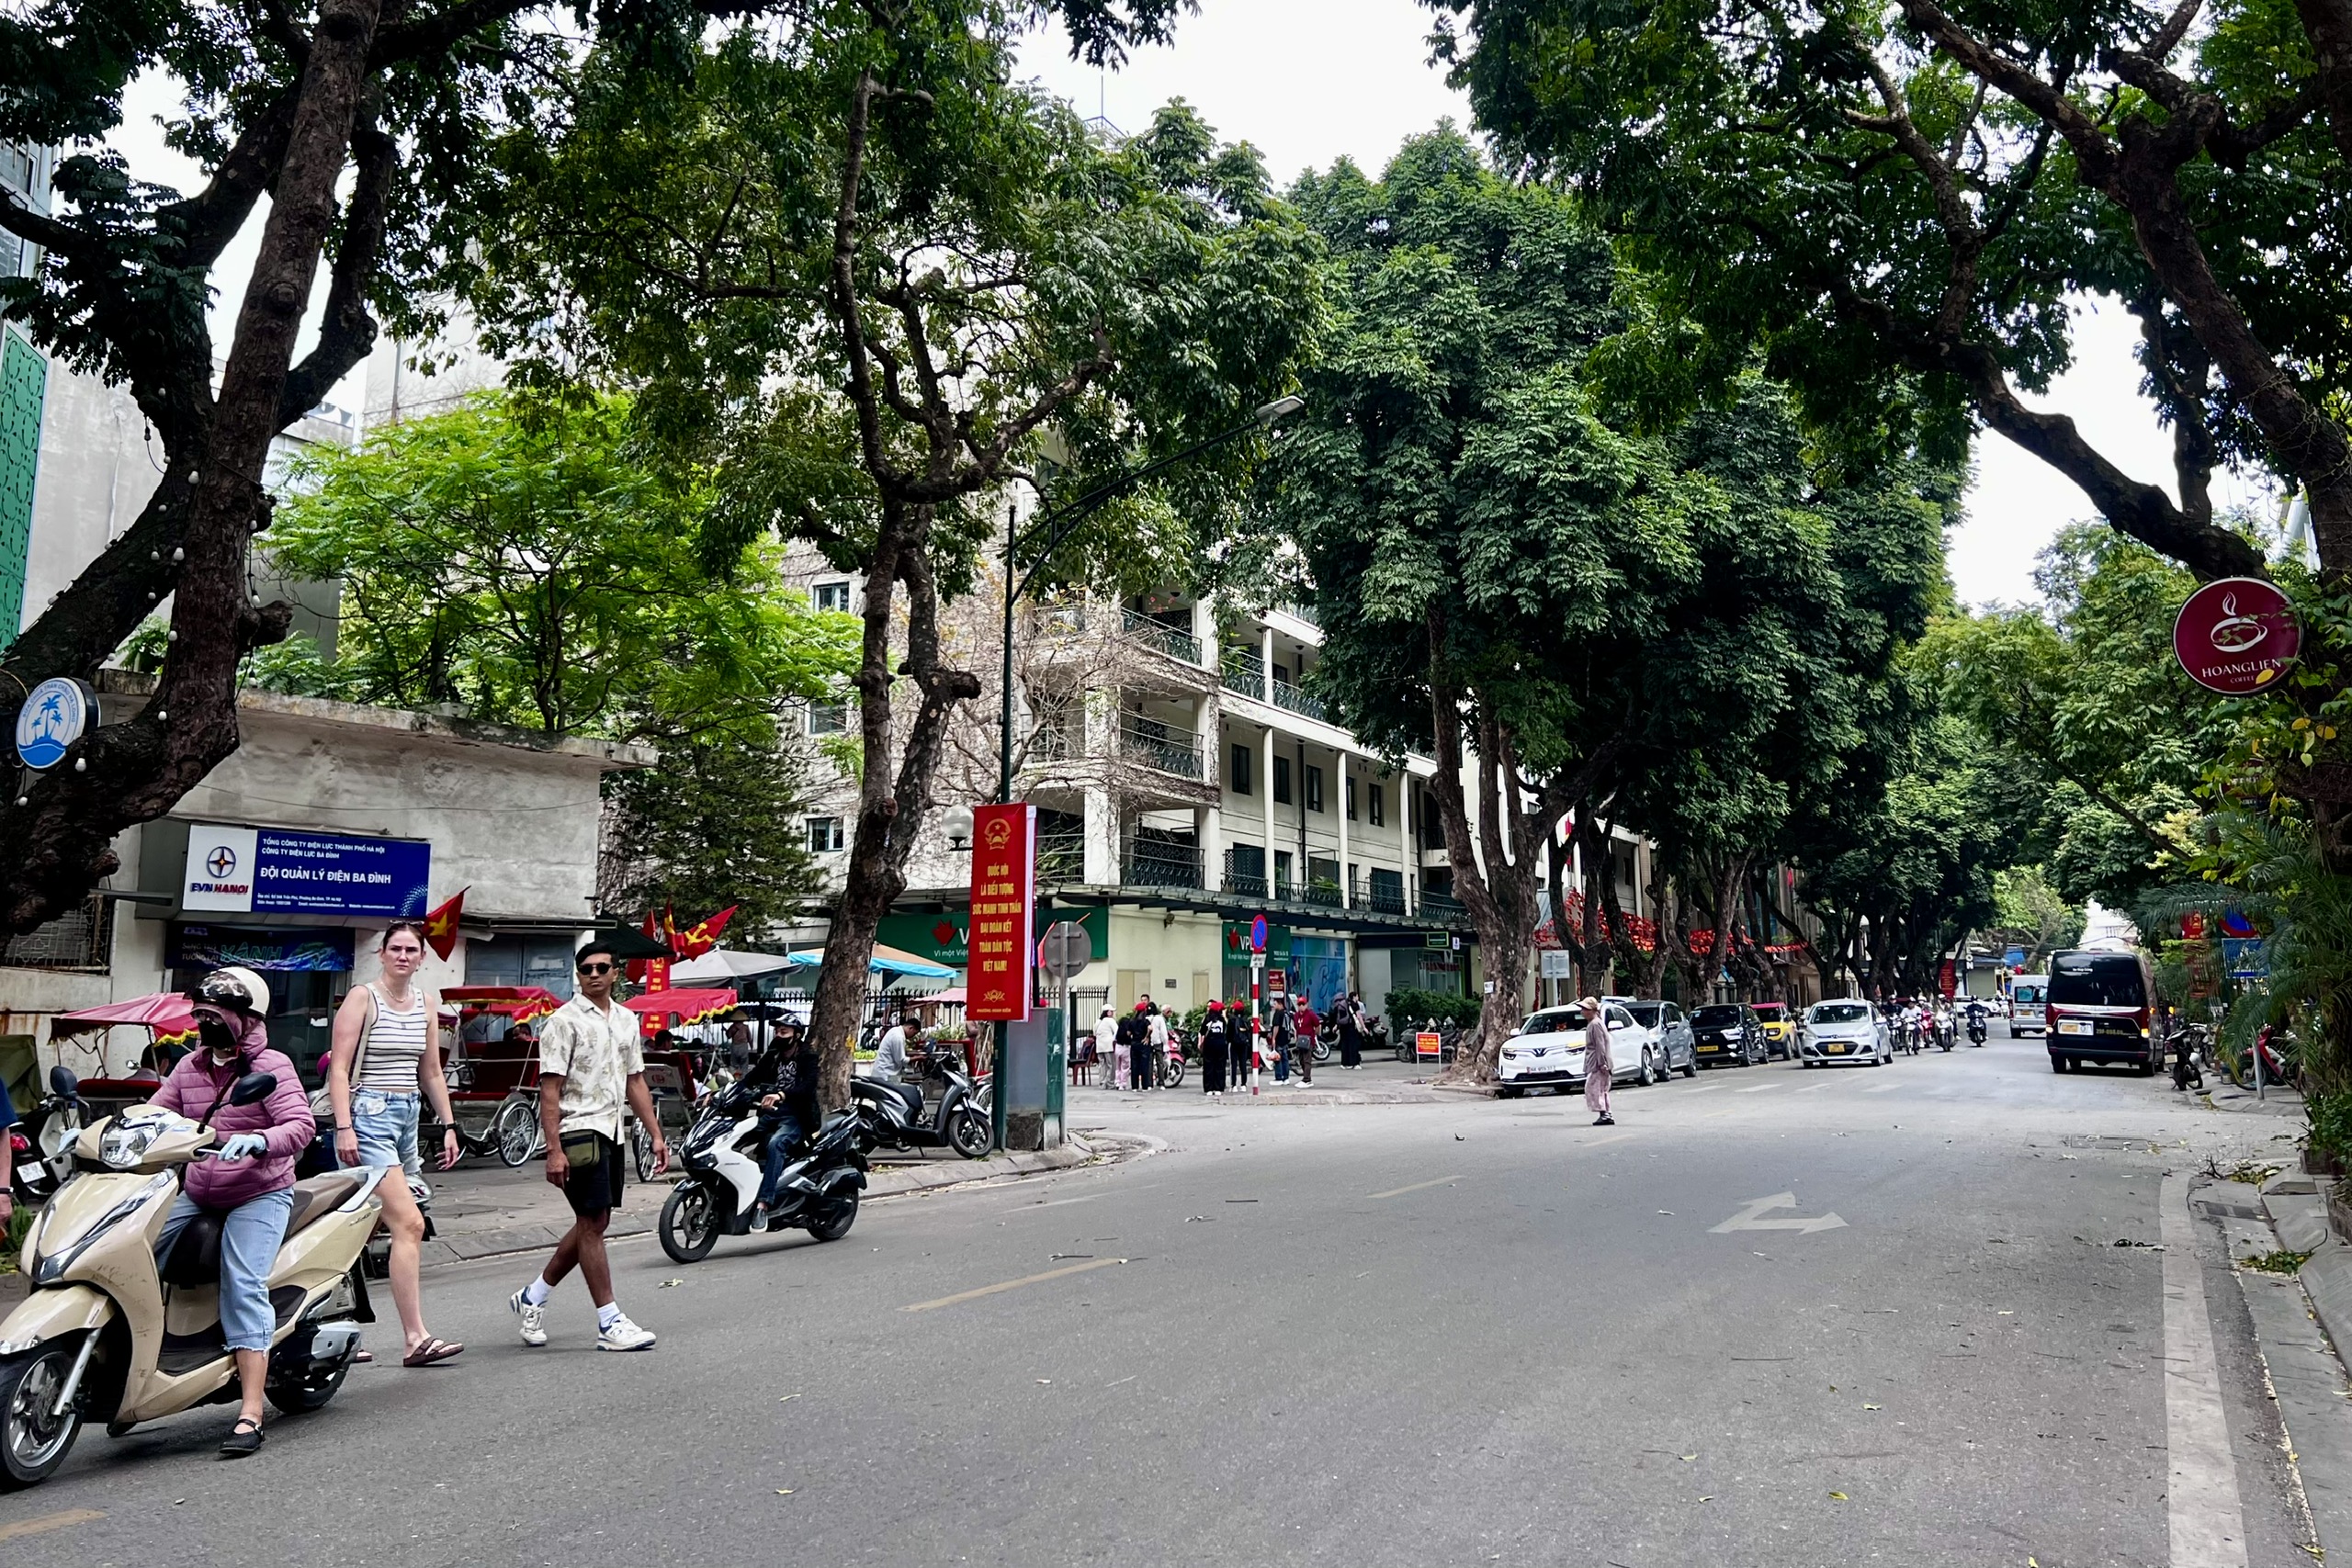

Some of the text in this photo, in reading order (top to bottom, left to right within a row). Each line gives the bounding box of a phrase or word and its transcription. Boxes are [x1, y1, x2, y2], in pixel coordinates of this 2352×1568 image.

[2201, 659, 2281, 678] HOANGLIEN
[280, 839, 298, 848] CÔNG
[261, 846, 279, 855] CÔNG
[316, 851, 325, 859] BA
[260, 865, 391, 884] ĐỘI QUẢN LÝ ĐIỆN BA ĐÌNH
[190, 882, 249, 895] EVN HANOI
[942, 949, 955, 958] một
